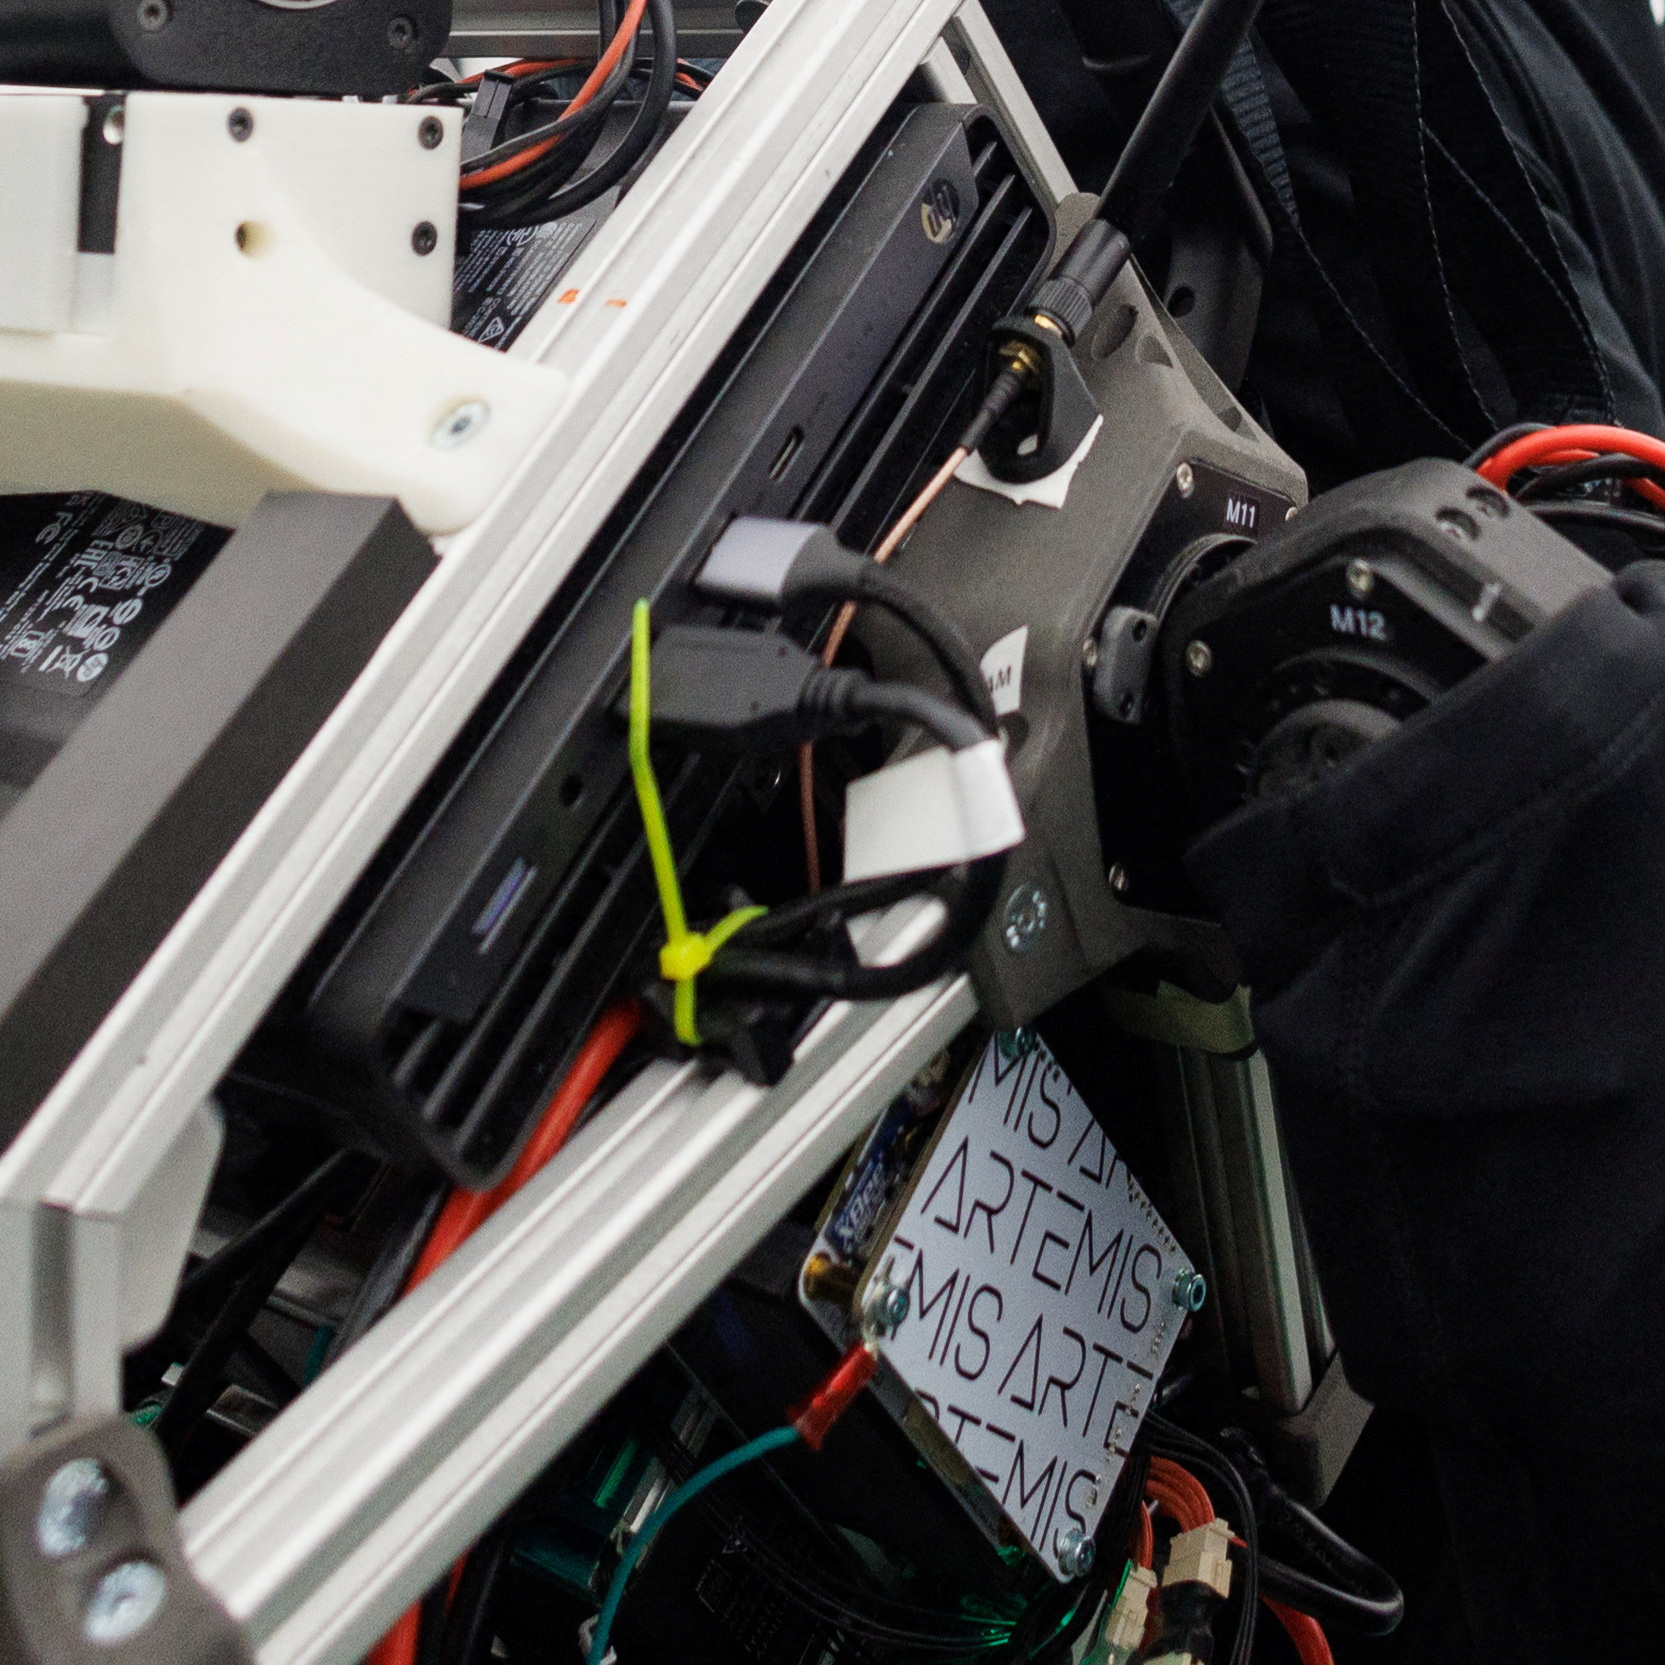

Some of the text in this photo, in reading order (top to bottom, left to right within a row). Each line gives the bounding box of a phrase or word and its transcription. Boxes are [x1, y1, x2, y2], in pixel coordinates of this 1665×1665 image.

[1225, 497, 1256, 528] M11
[1329, 603, 1387, 642] M12
[920, 1135, 1163, 1334] ARTEMIS
[888, 1235, 1154, 1460] MIS ARTE
